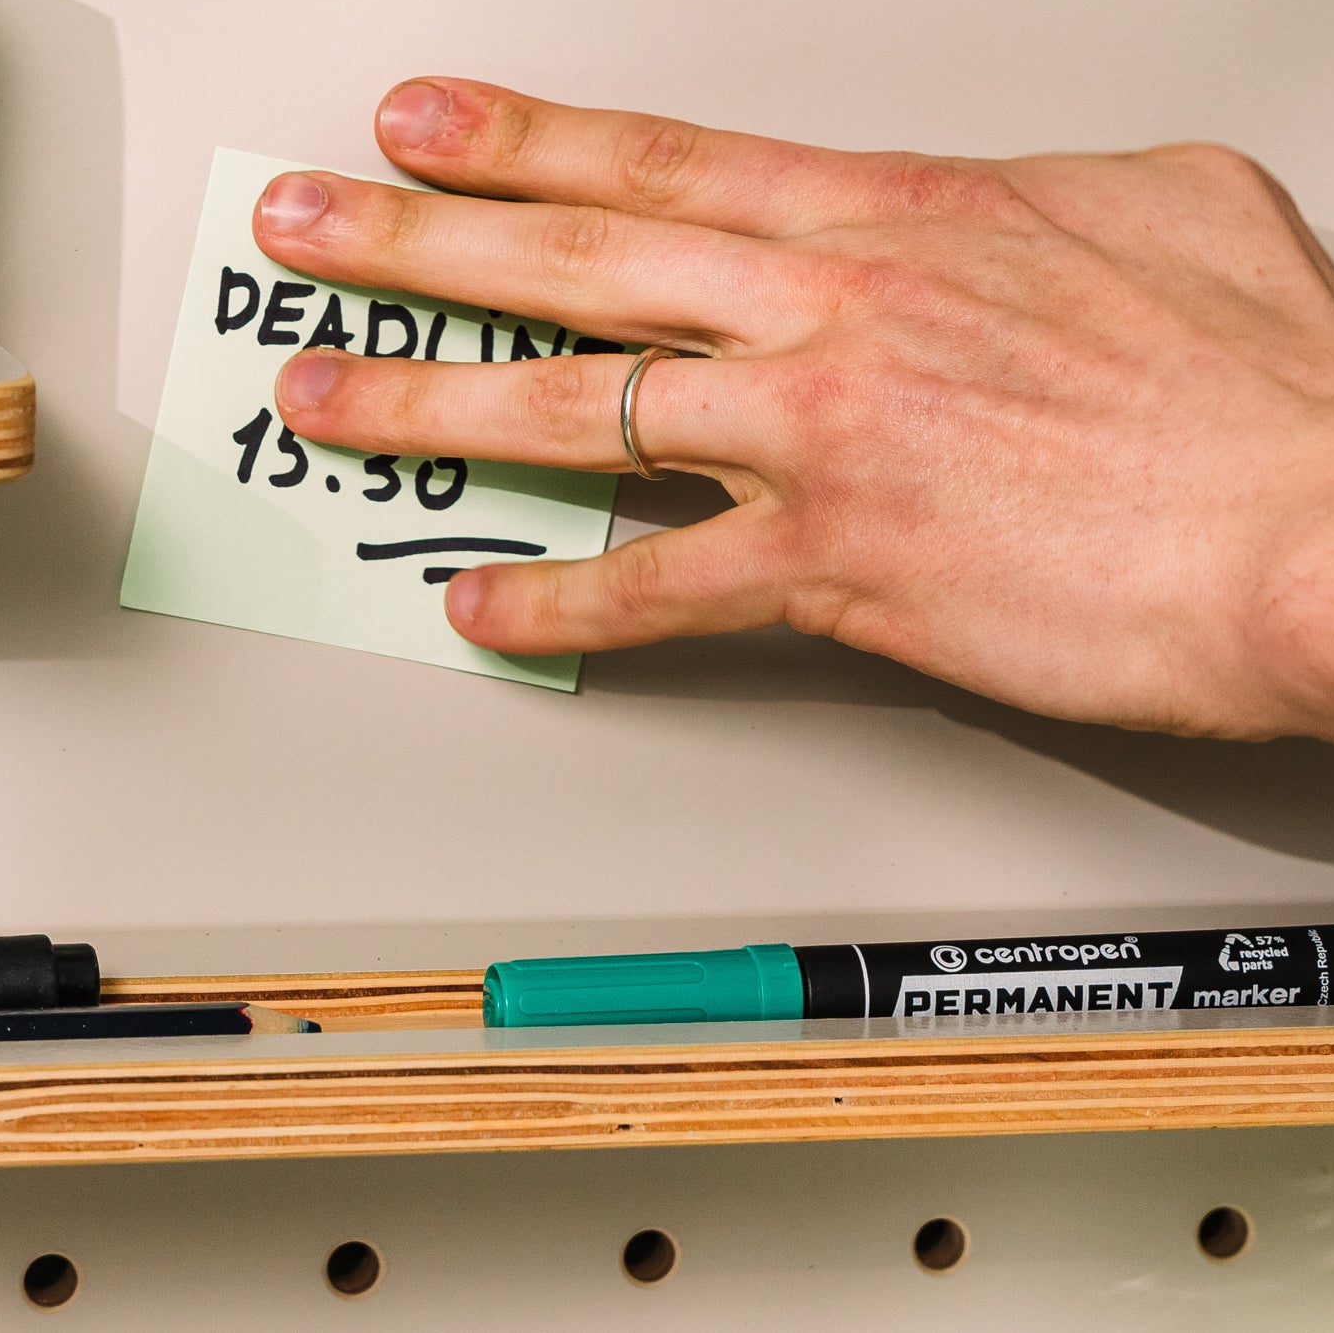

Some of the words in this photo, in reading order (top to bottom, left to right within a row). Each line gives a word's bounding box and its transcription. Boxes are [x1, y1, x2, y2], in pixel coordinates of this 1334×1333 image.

[1239, 946, 1289, 960] recycled
[1242, 959, 1274, 973] parts
[1308, 929, 1328, 969] Republic
[904, 981, 1173, 1016] PERMANENT
[1193, 983, 1301, 1008] marker
[1317, 971, 1329, 1006] Czech
